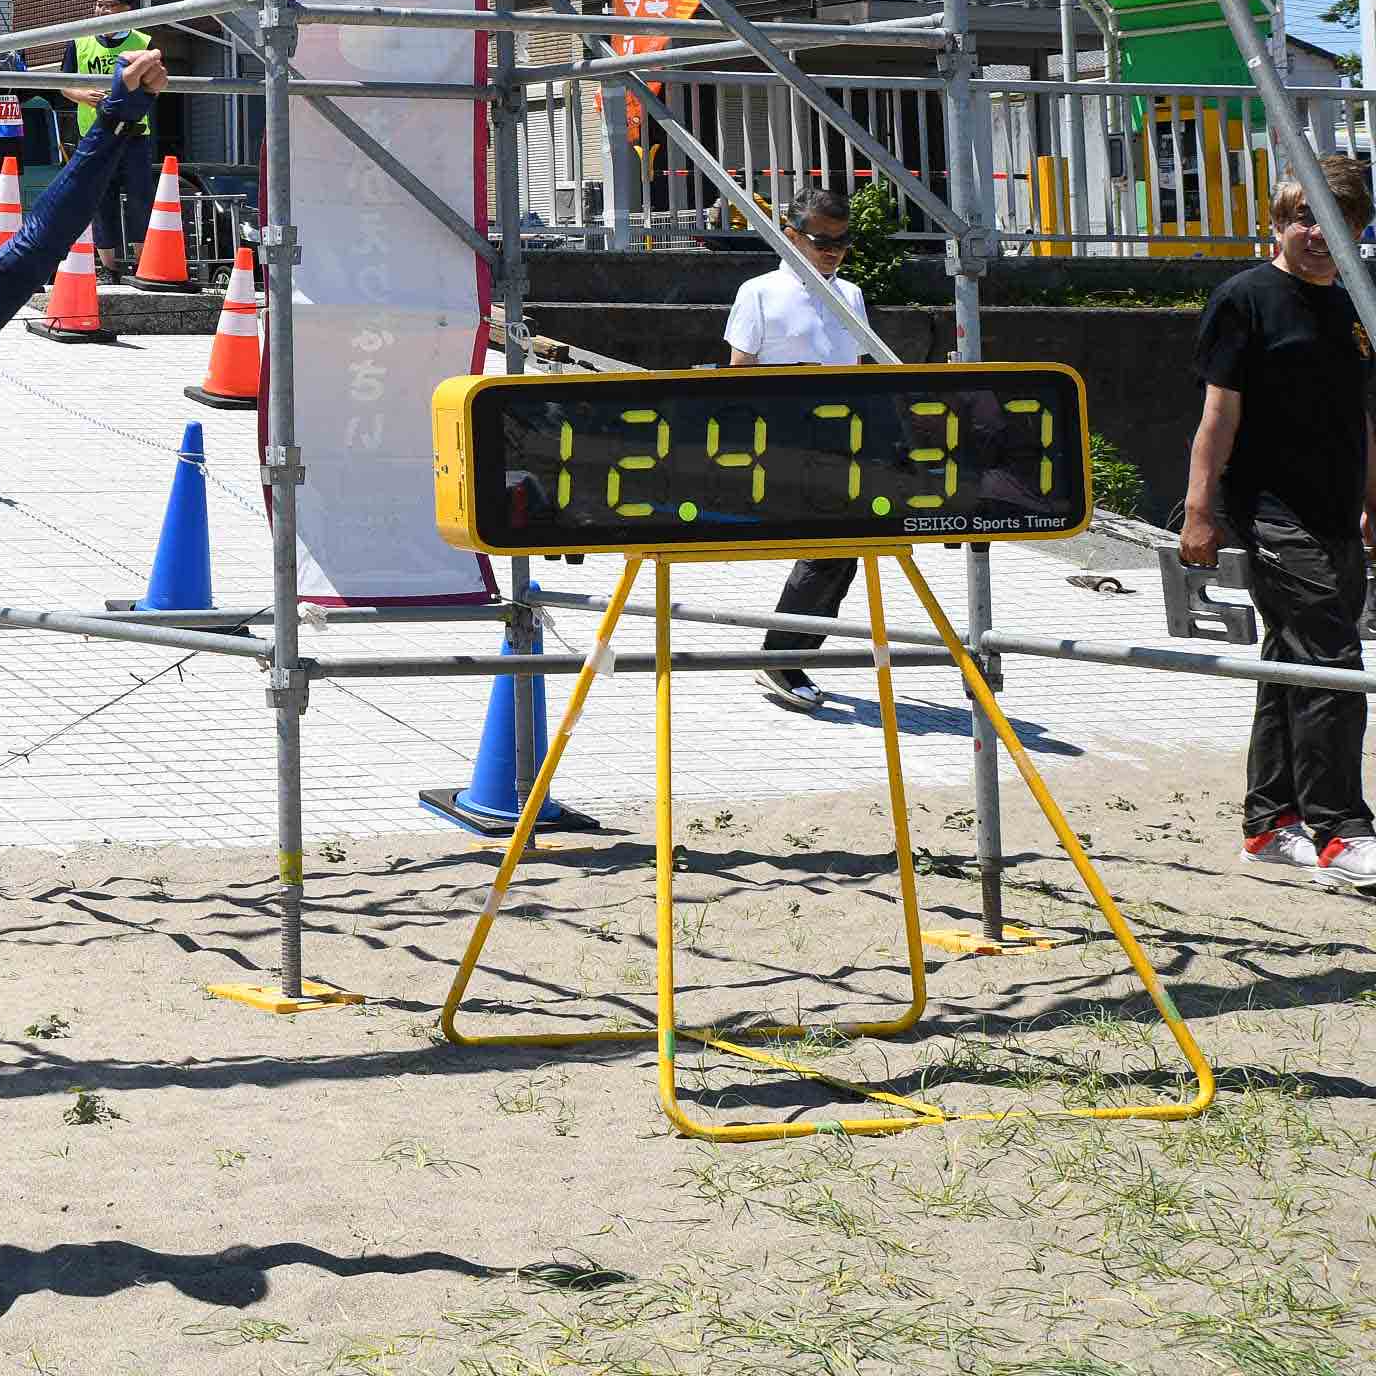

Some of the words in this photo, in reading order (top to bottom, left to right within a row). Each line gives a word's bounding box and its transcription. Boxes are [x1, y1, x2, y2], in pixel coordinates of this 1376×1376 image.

[903, 515, 968, 533] SEIKO
[972, 514, 1021, 532] Sports
[1024, 513, 1067, 530] Timer
